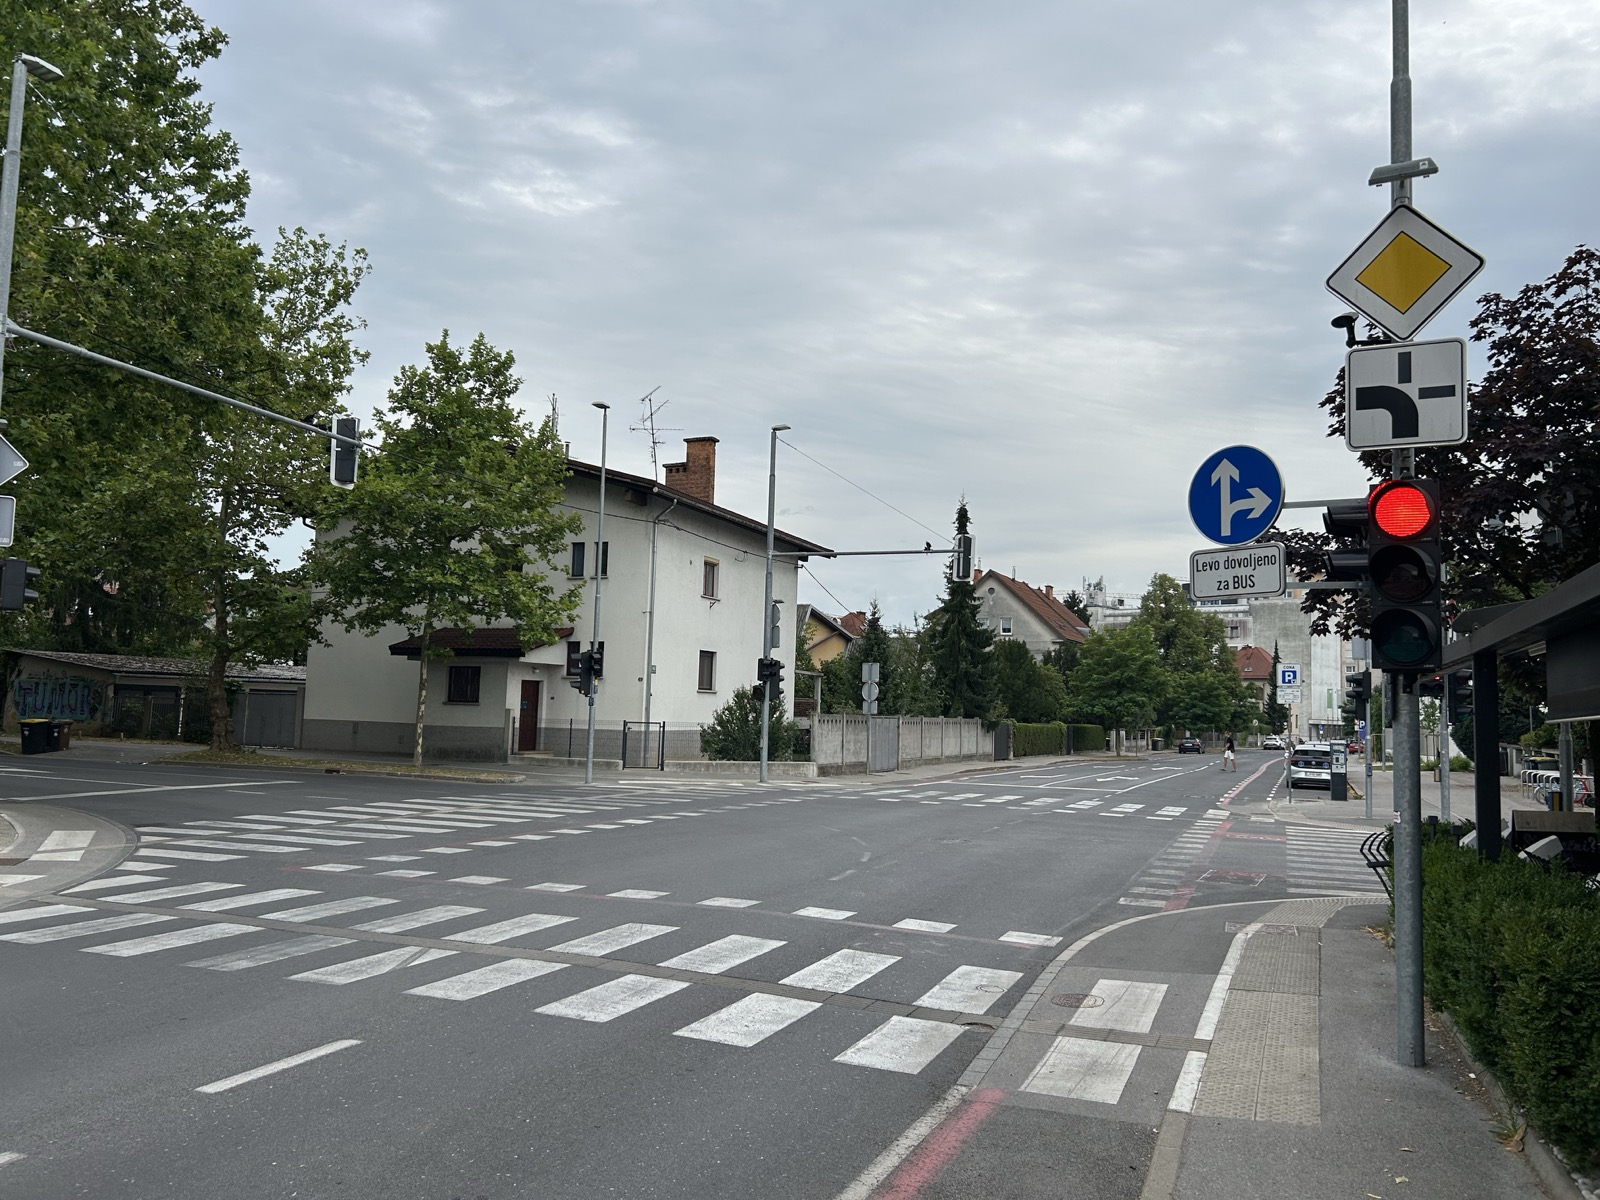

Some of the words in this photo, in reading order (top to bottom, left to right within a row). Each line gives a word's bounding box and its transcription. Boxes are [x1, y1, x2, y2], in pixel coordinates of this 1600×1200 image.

[1196, 558, 1220, 573] Levo
[1223, 553, 1277, 571] dovoljeno
[1216, 579, 1230, 591] za
[1233, 574, 1256, 590] BUS
[1285, 672, 1294, 682] P
